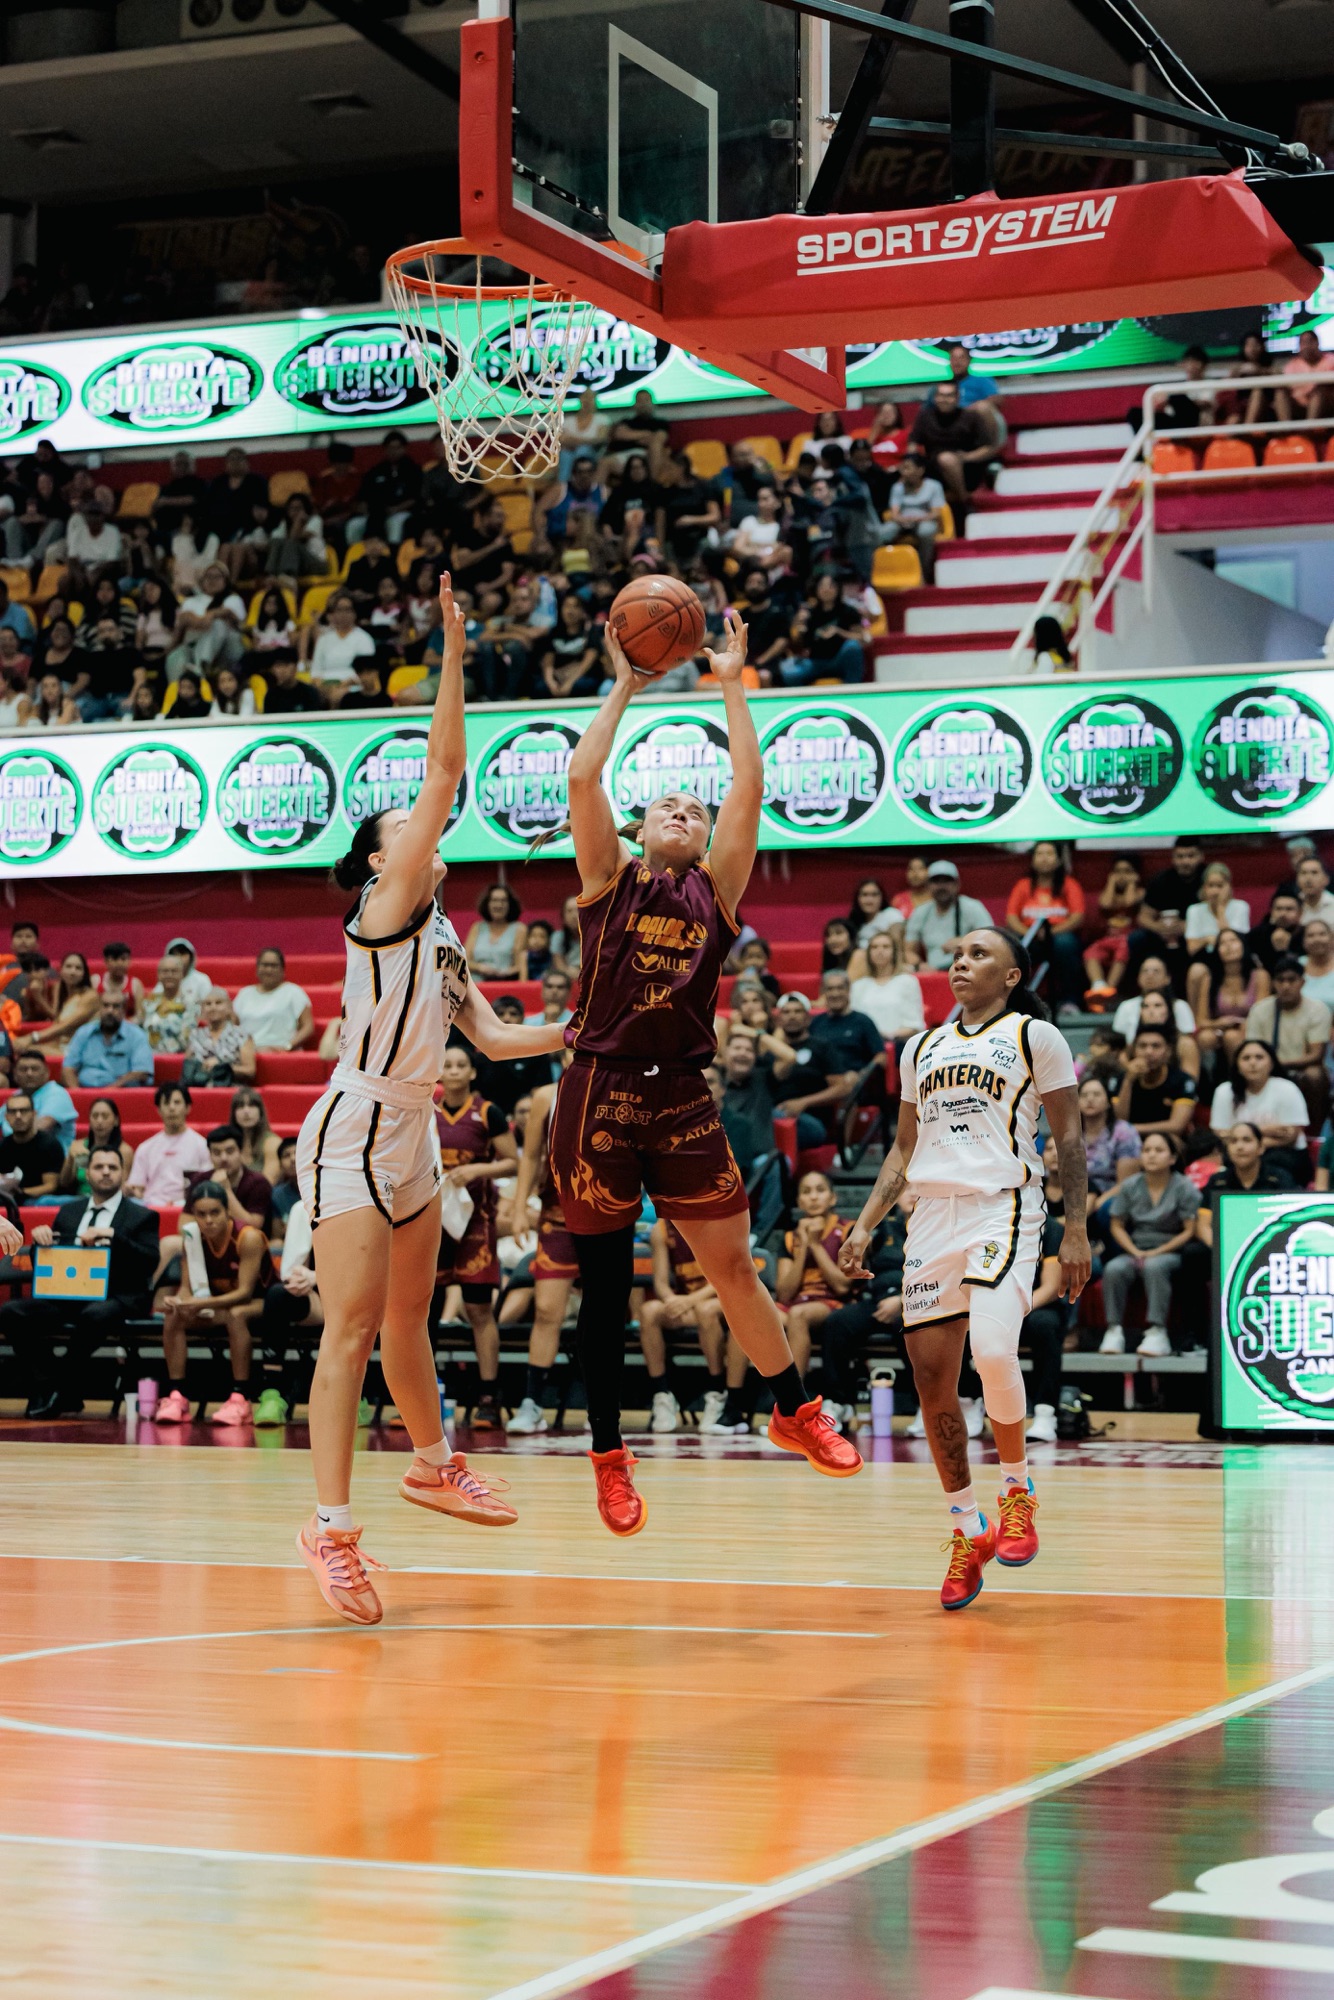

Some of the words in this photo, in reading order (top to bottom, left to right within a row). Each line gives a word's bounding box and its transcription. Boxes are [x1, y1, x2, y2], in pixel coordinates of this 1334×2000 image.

[797, 195, 1117, 264] SPORTSYSTEM
[115, 357, 227, 384] BENDITA
[88, 374, 250, 416] SUERTE
[1067, 722, 1157, 750] BENDITA
[1220, 713, 1310, 744] BENDITA
[635, 741, 718, 769] BENDITA
[776, 735, 859, 763] BENDITA
[919, 729, 1006, 757] BENDITA
[114, 767, 186, 792] BENDITA
[239, 762, 313, 787] BENDITA
[898, 755, 1024, 800] SUERTE
[96, 794, 199, 833] SUERTE
[220, 785, 328, 829] SUERTE
[990, 1048, 1017, 1064] Red
[994, 1060, 1012, 1070] Cola
[917, 1063, 1007, 1105] PANTERAS
[685, 1118, 721, 1142] ATLAS
[906, 1296, 940, 1312] Fairfield
